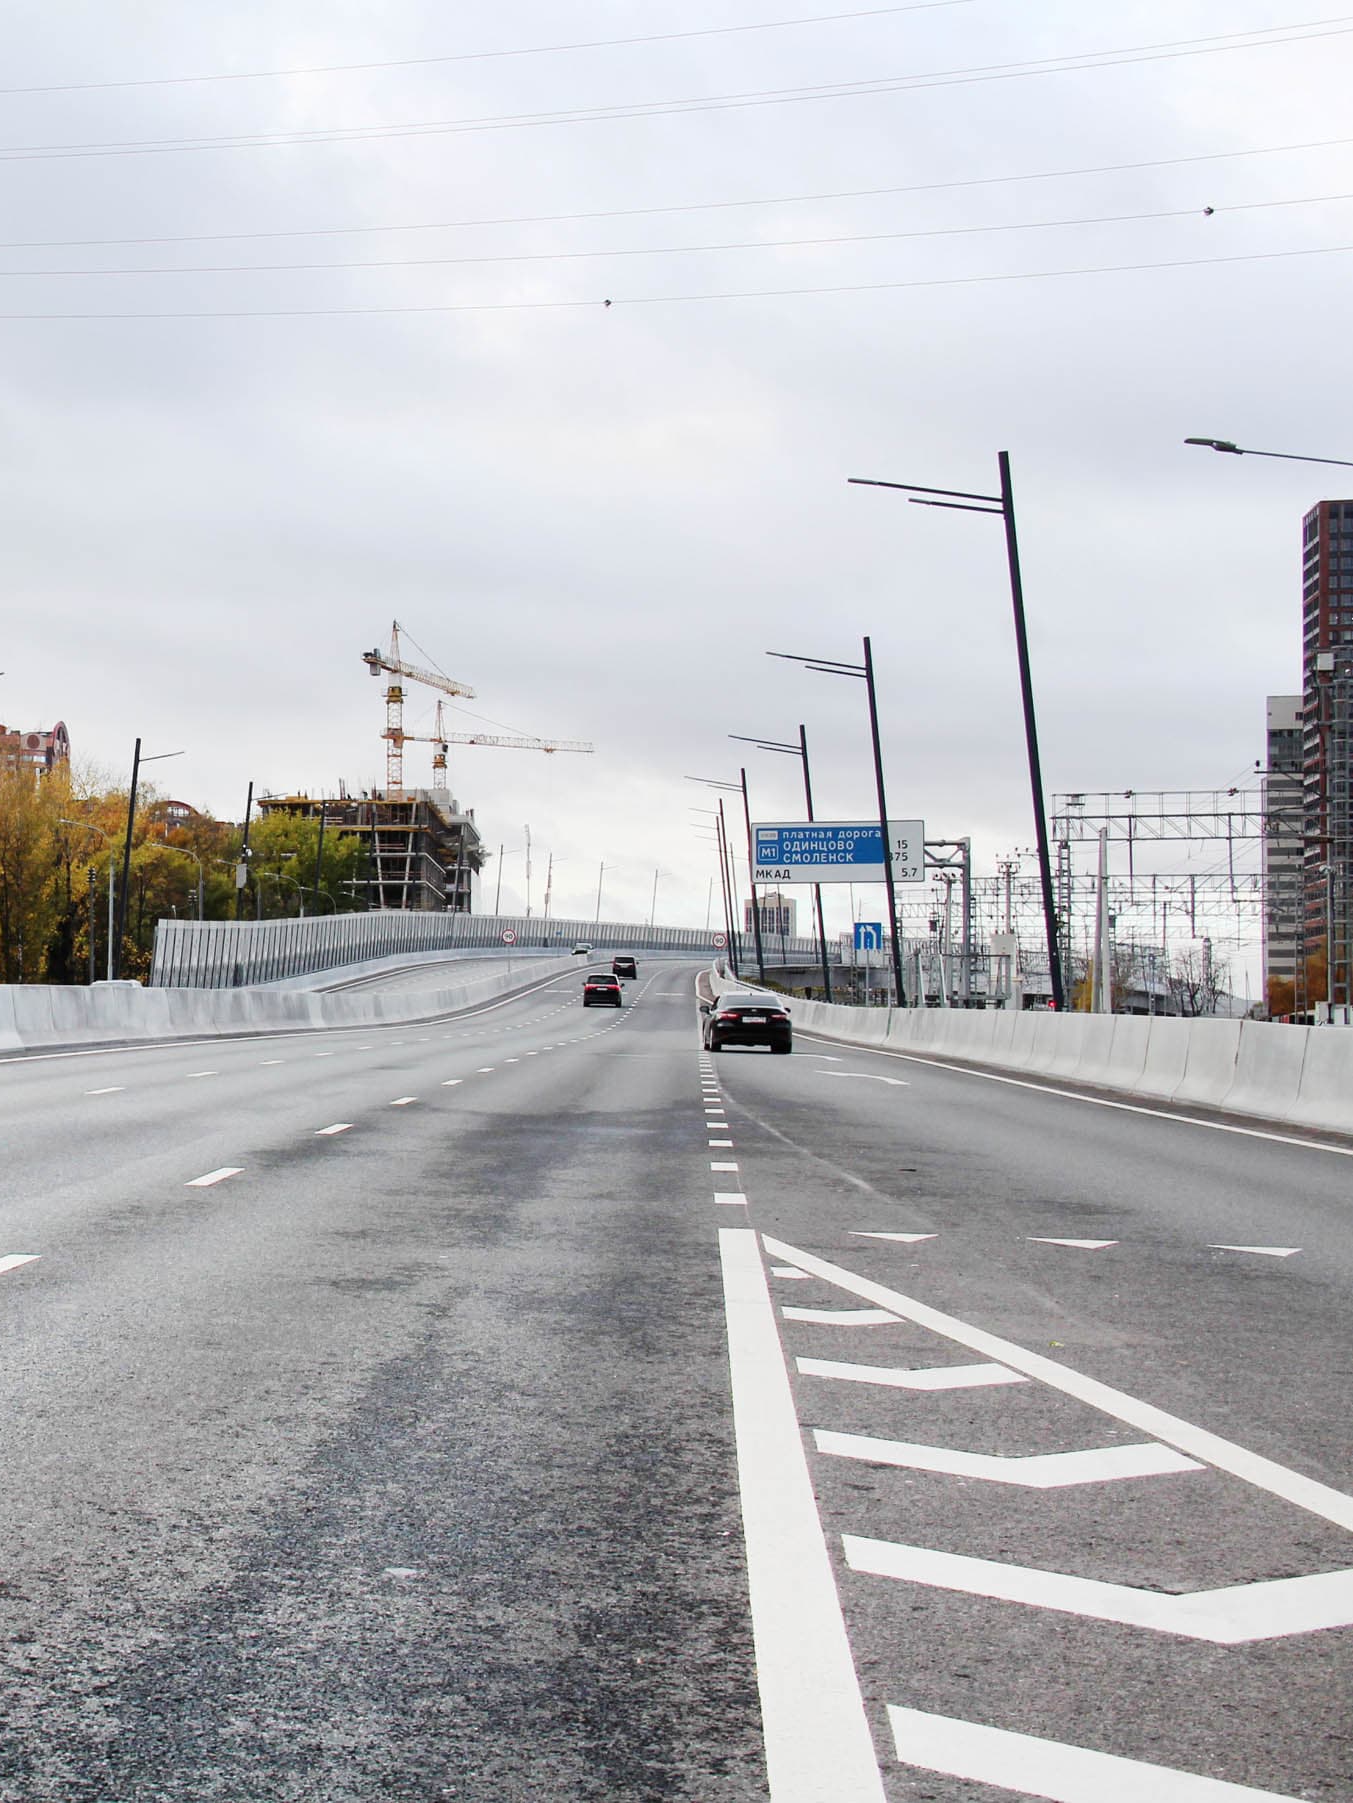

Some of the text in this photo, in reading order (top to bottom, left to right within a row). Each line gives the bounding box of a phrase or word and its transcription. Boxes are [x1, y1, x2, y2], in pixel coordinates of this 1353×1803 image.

[782, 831, 832, 839] платная
[837, 830, 882, 840] дорога
[783, 840, 854, 852] ОДИНЦОВО
[897, 839, 908, 849] 15
[783, 853, 854, 863] СМОЛЕНСК
[756, 869, 791, 879] МКАД
[901, 867, 918, 877] 5.7
